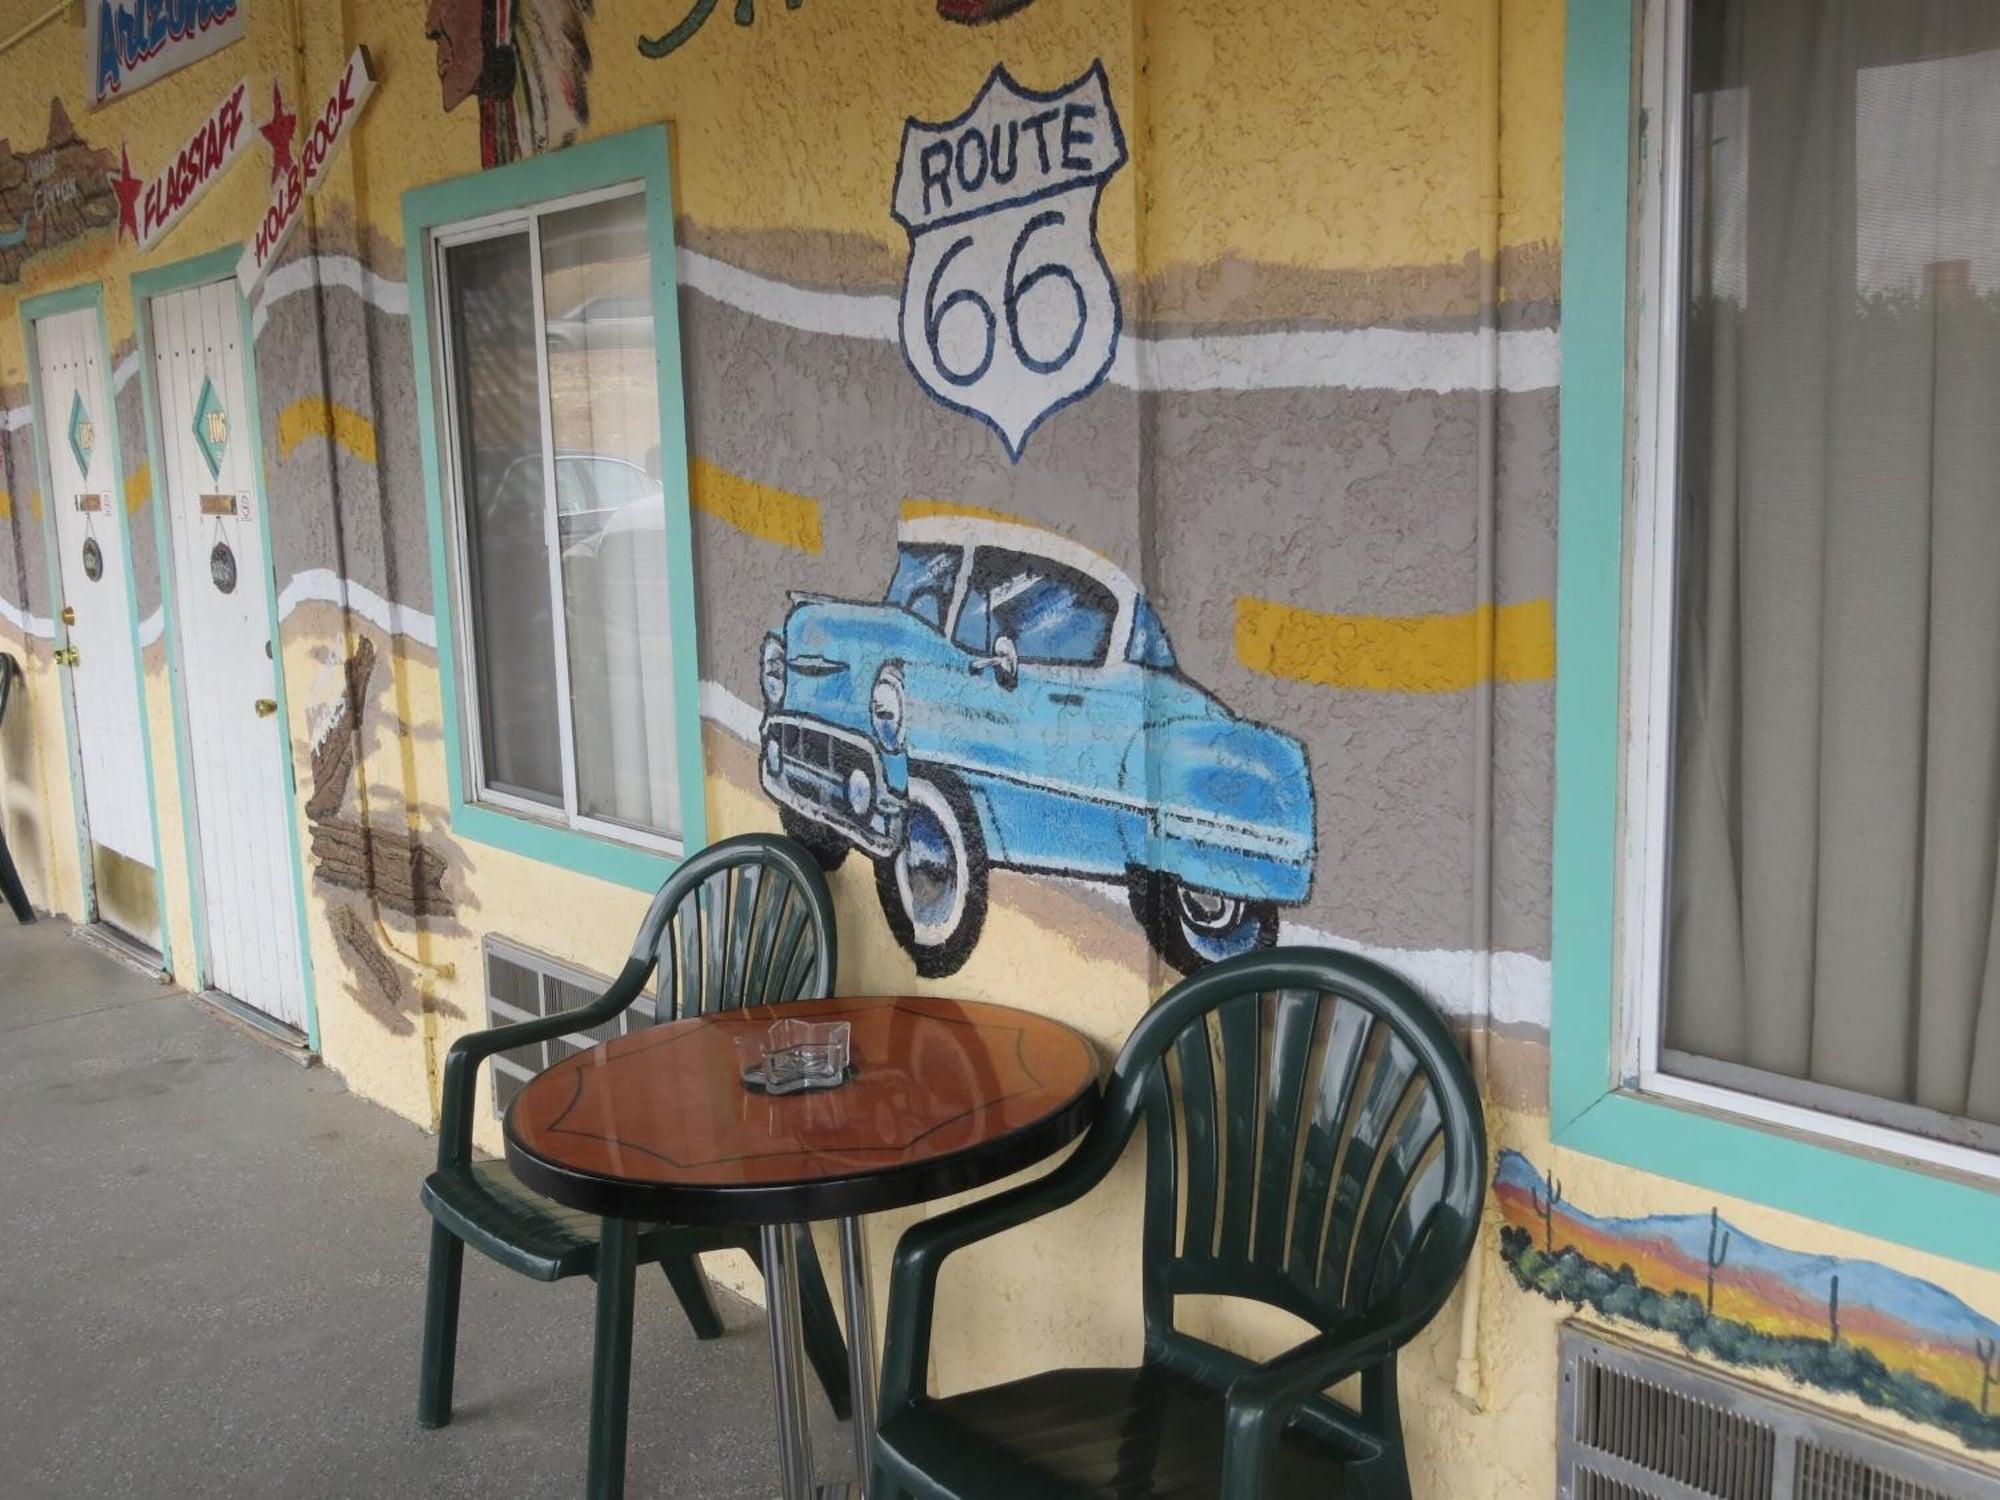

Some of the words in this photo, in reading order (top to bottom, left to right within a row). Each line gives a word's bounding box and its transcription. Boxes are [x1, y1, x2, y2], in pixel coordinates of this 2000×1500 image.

[144, 84, 244, 239] FLAGSTAFF
[921, 104, 1096, 215] ROUTE
[924, 211, 1087, 387] 66
[207, 411, 227, 444] 106
